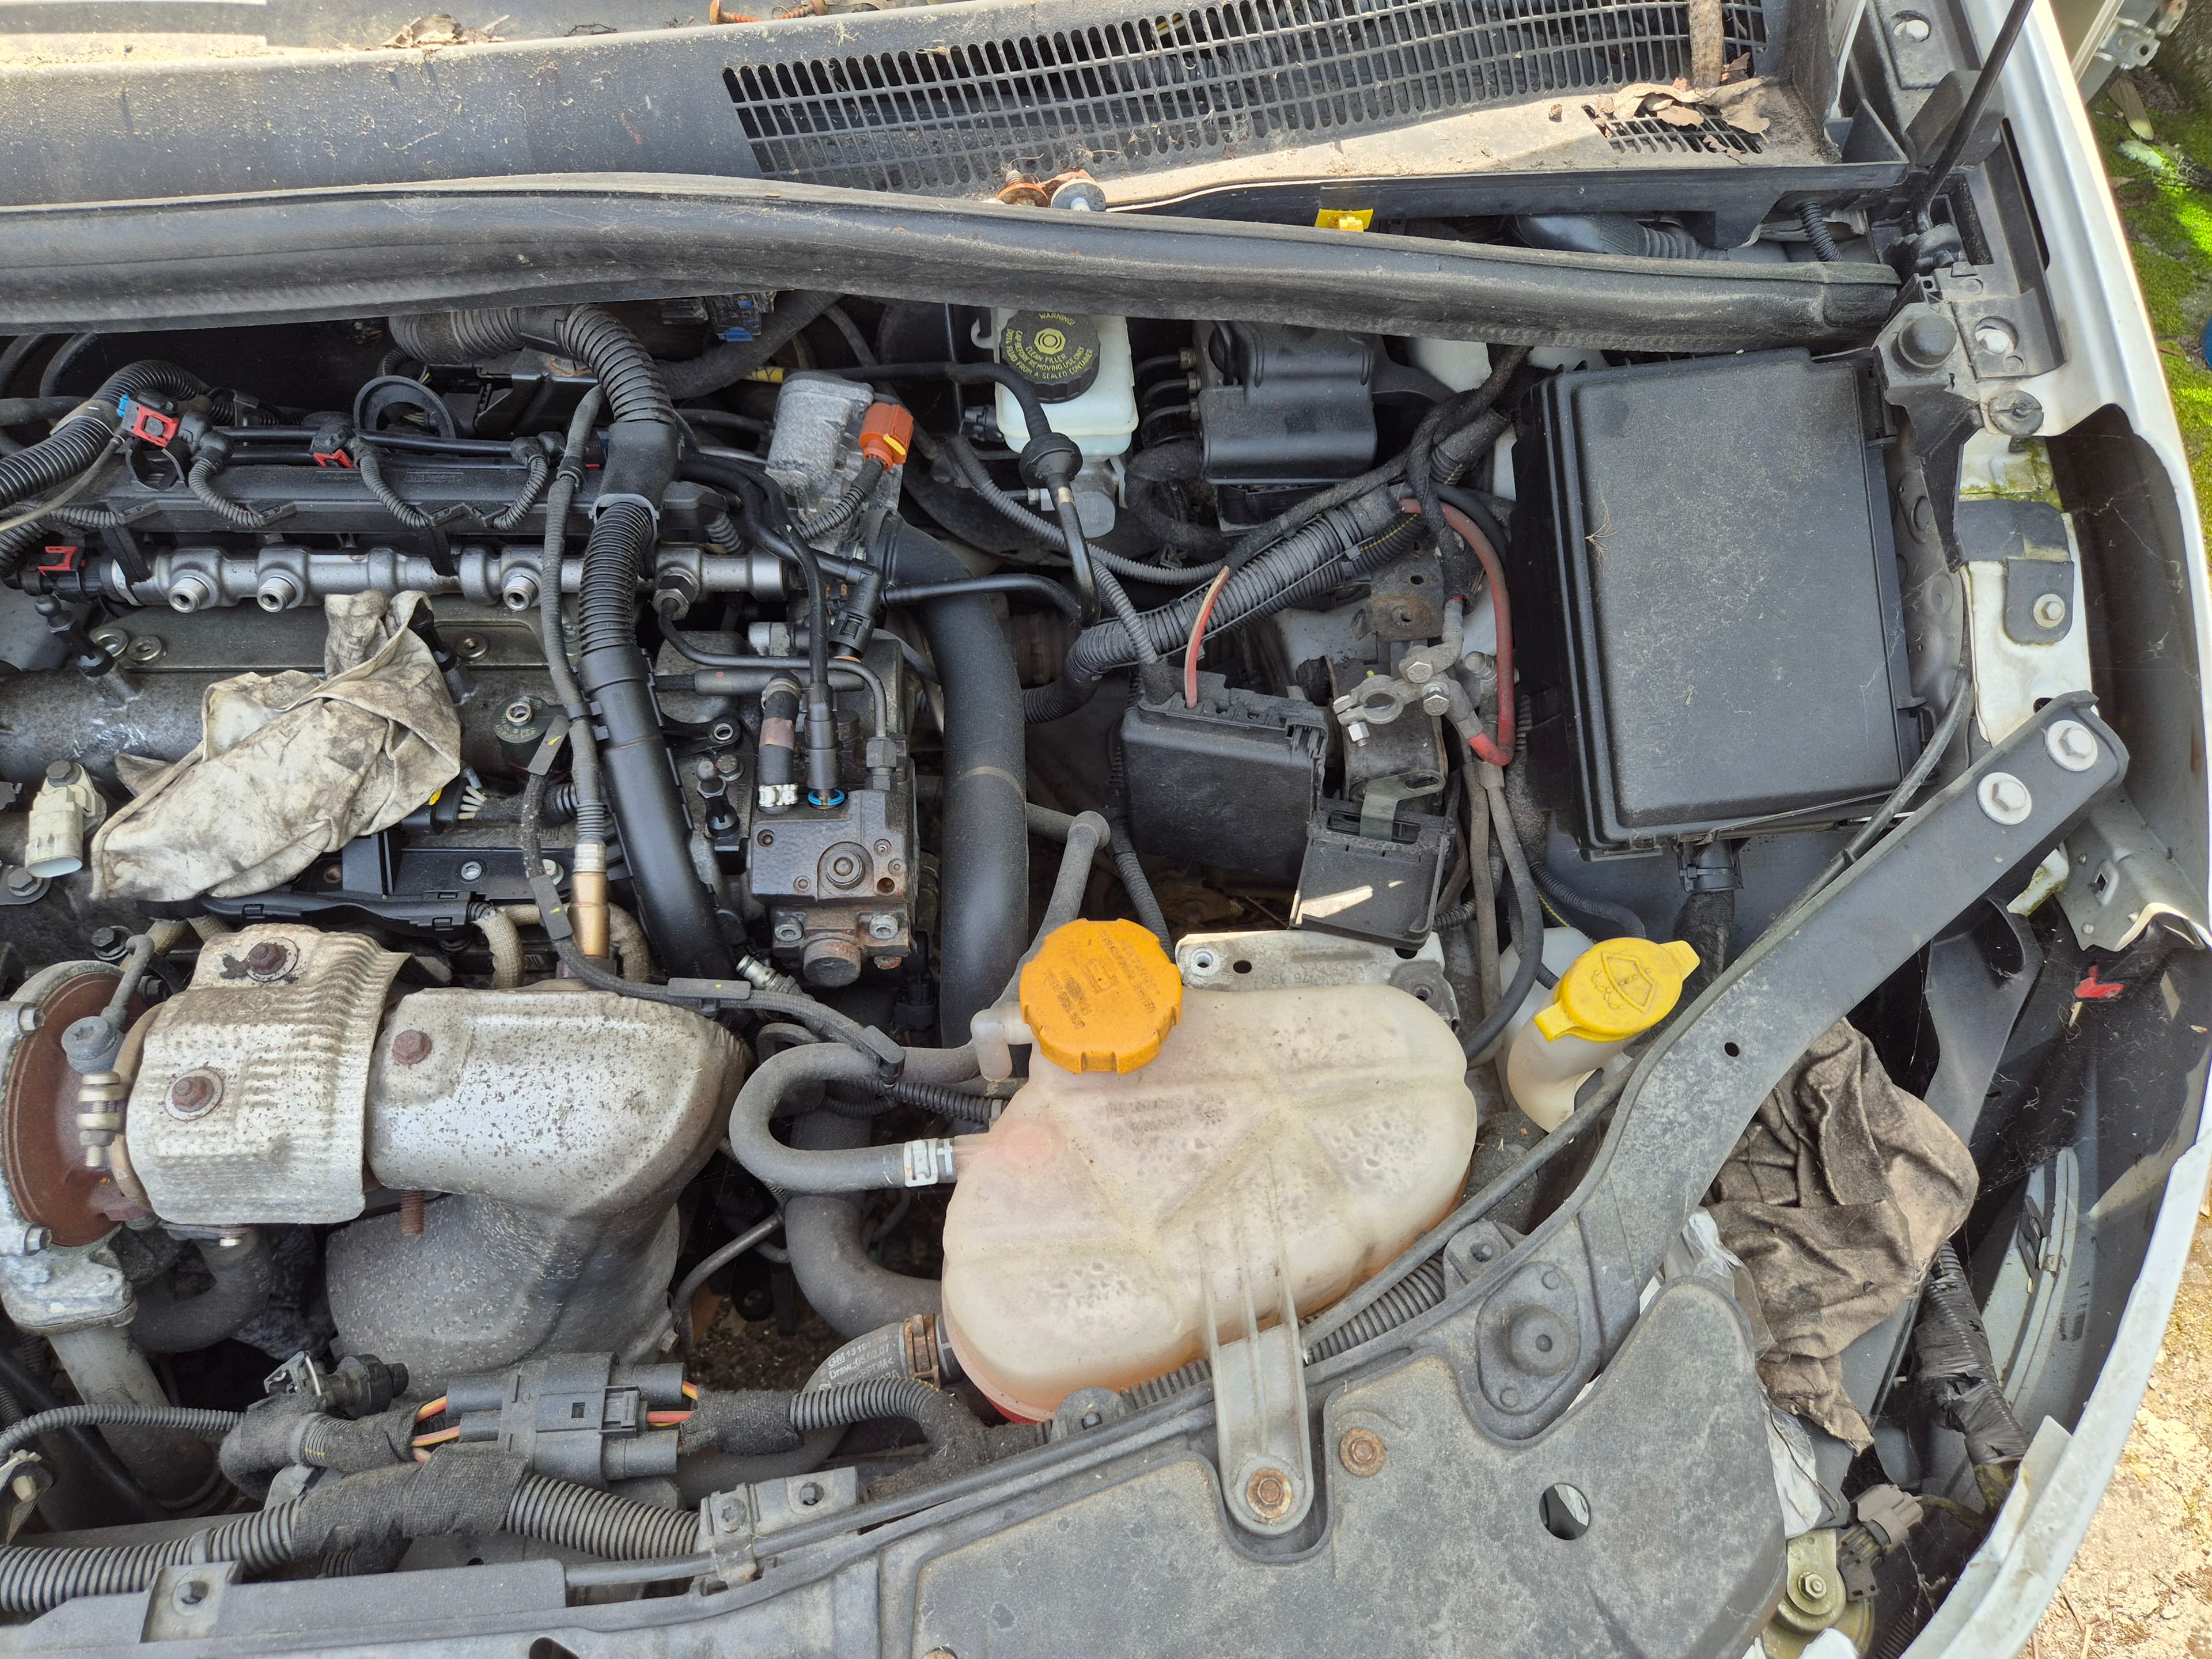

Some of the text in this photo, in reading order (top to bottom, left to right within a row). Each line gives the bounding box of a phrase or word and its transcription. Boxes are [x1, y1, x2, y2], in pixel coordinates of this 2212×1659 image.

[1039, 313, 1075, 326] WARNING!
[1006, 346, 1017, 362] FLUID
[1016, 362, 1032, 374] FROM
[1042, 372, 1067, 380] SEALED
[1069, 349, 1093, 374] CONTAINER
[1015, 343, 1029, 362] BEFORE
[1029, 360, 1062, 371] REMOVING
[1063, 359, 1076, 368] USE
[1073, 346, 1085, 360] ONLY
[1025, 346, 1067, 363] CLEAN FILLER
[828, 1352, 845, 1368] GM
